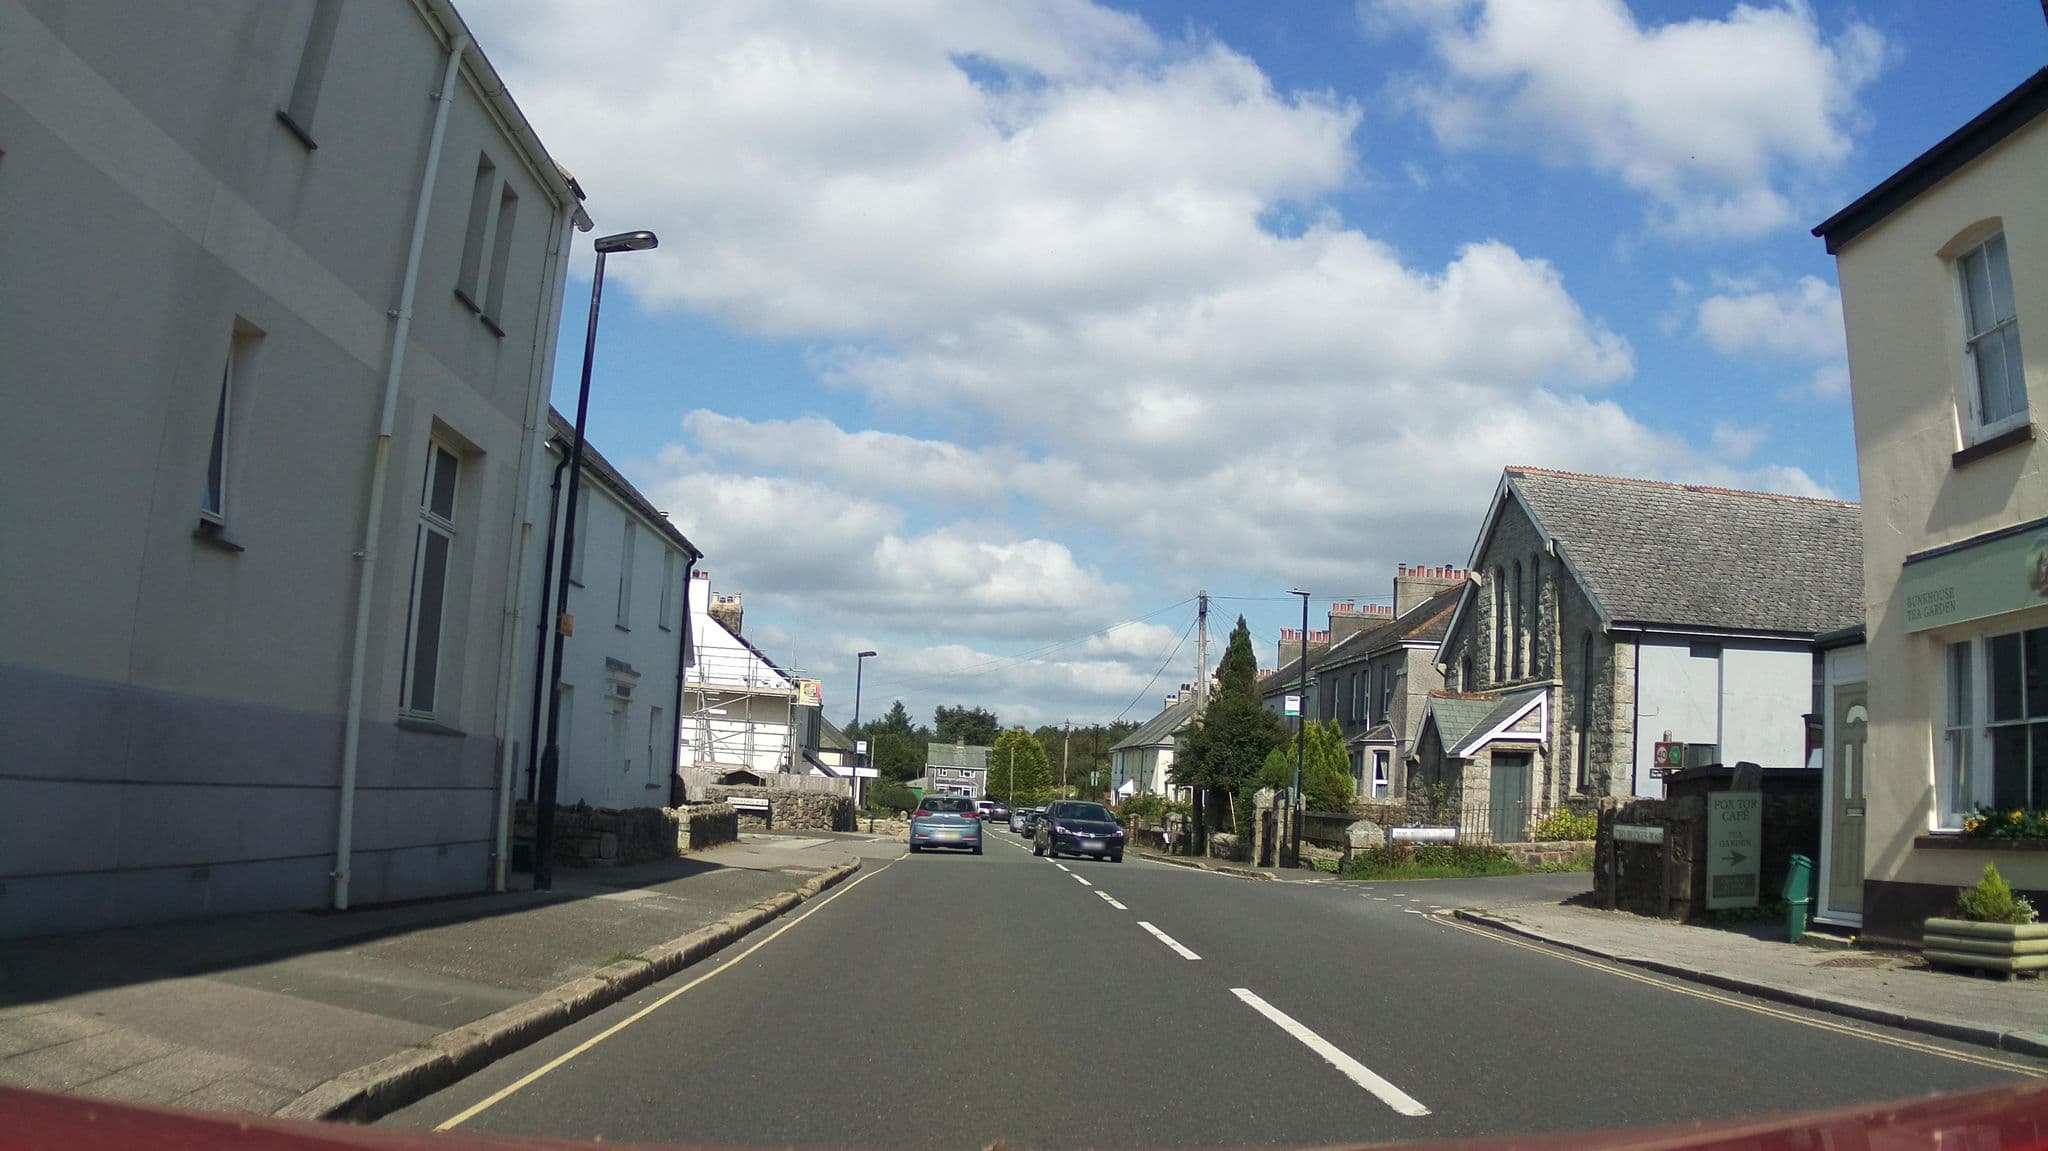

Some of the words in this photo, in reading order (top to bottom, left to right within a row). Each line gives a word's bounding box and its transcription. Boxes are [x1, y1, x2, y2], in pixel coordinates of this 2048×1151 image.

[1906, 607, 1922, 622] TEA
[1924, 600, 1957, 617] GARDEN
[1714, 799, 1735, 810] FOX
[1737, 799, 1760, 809] TOR
